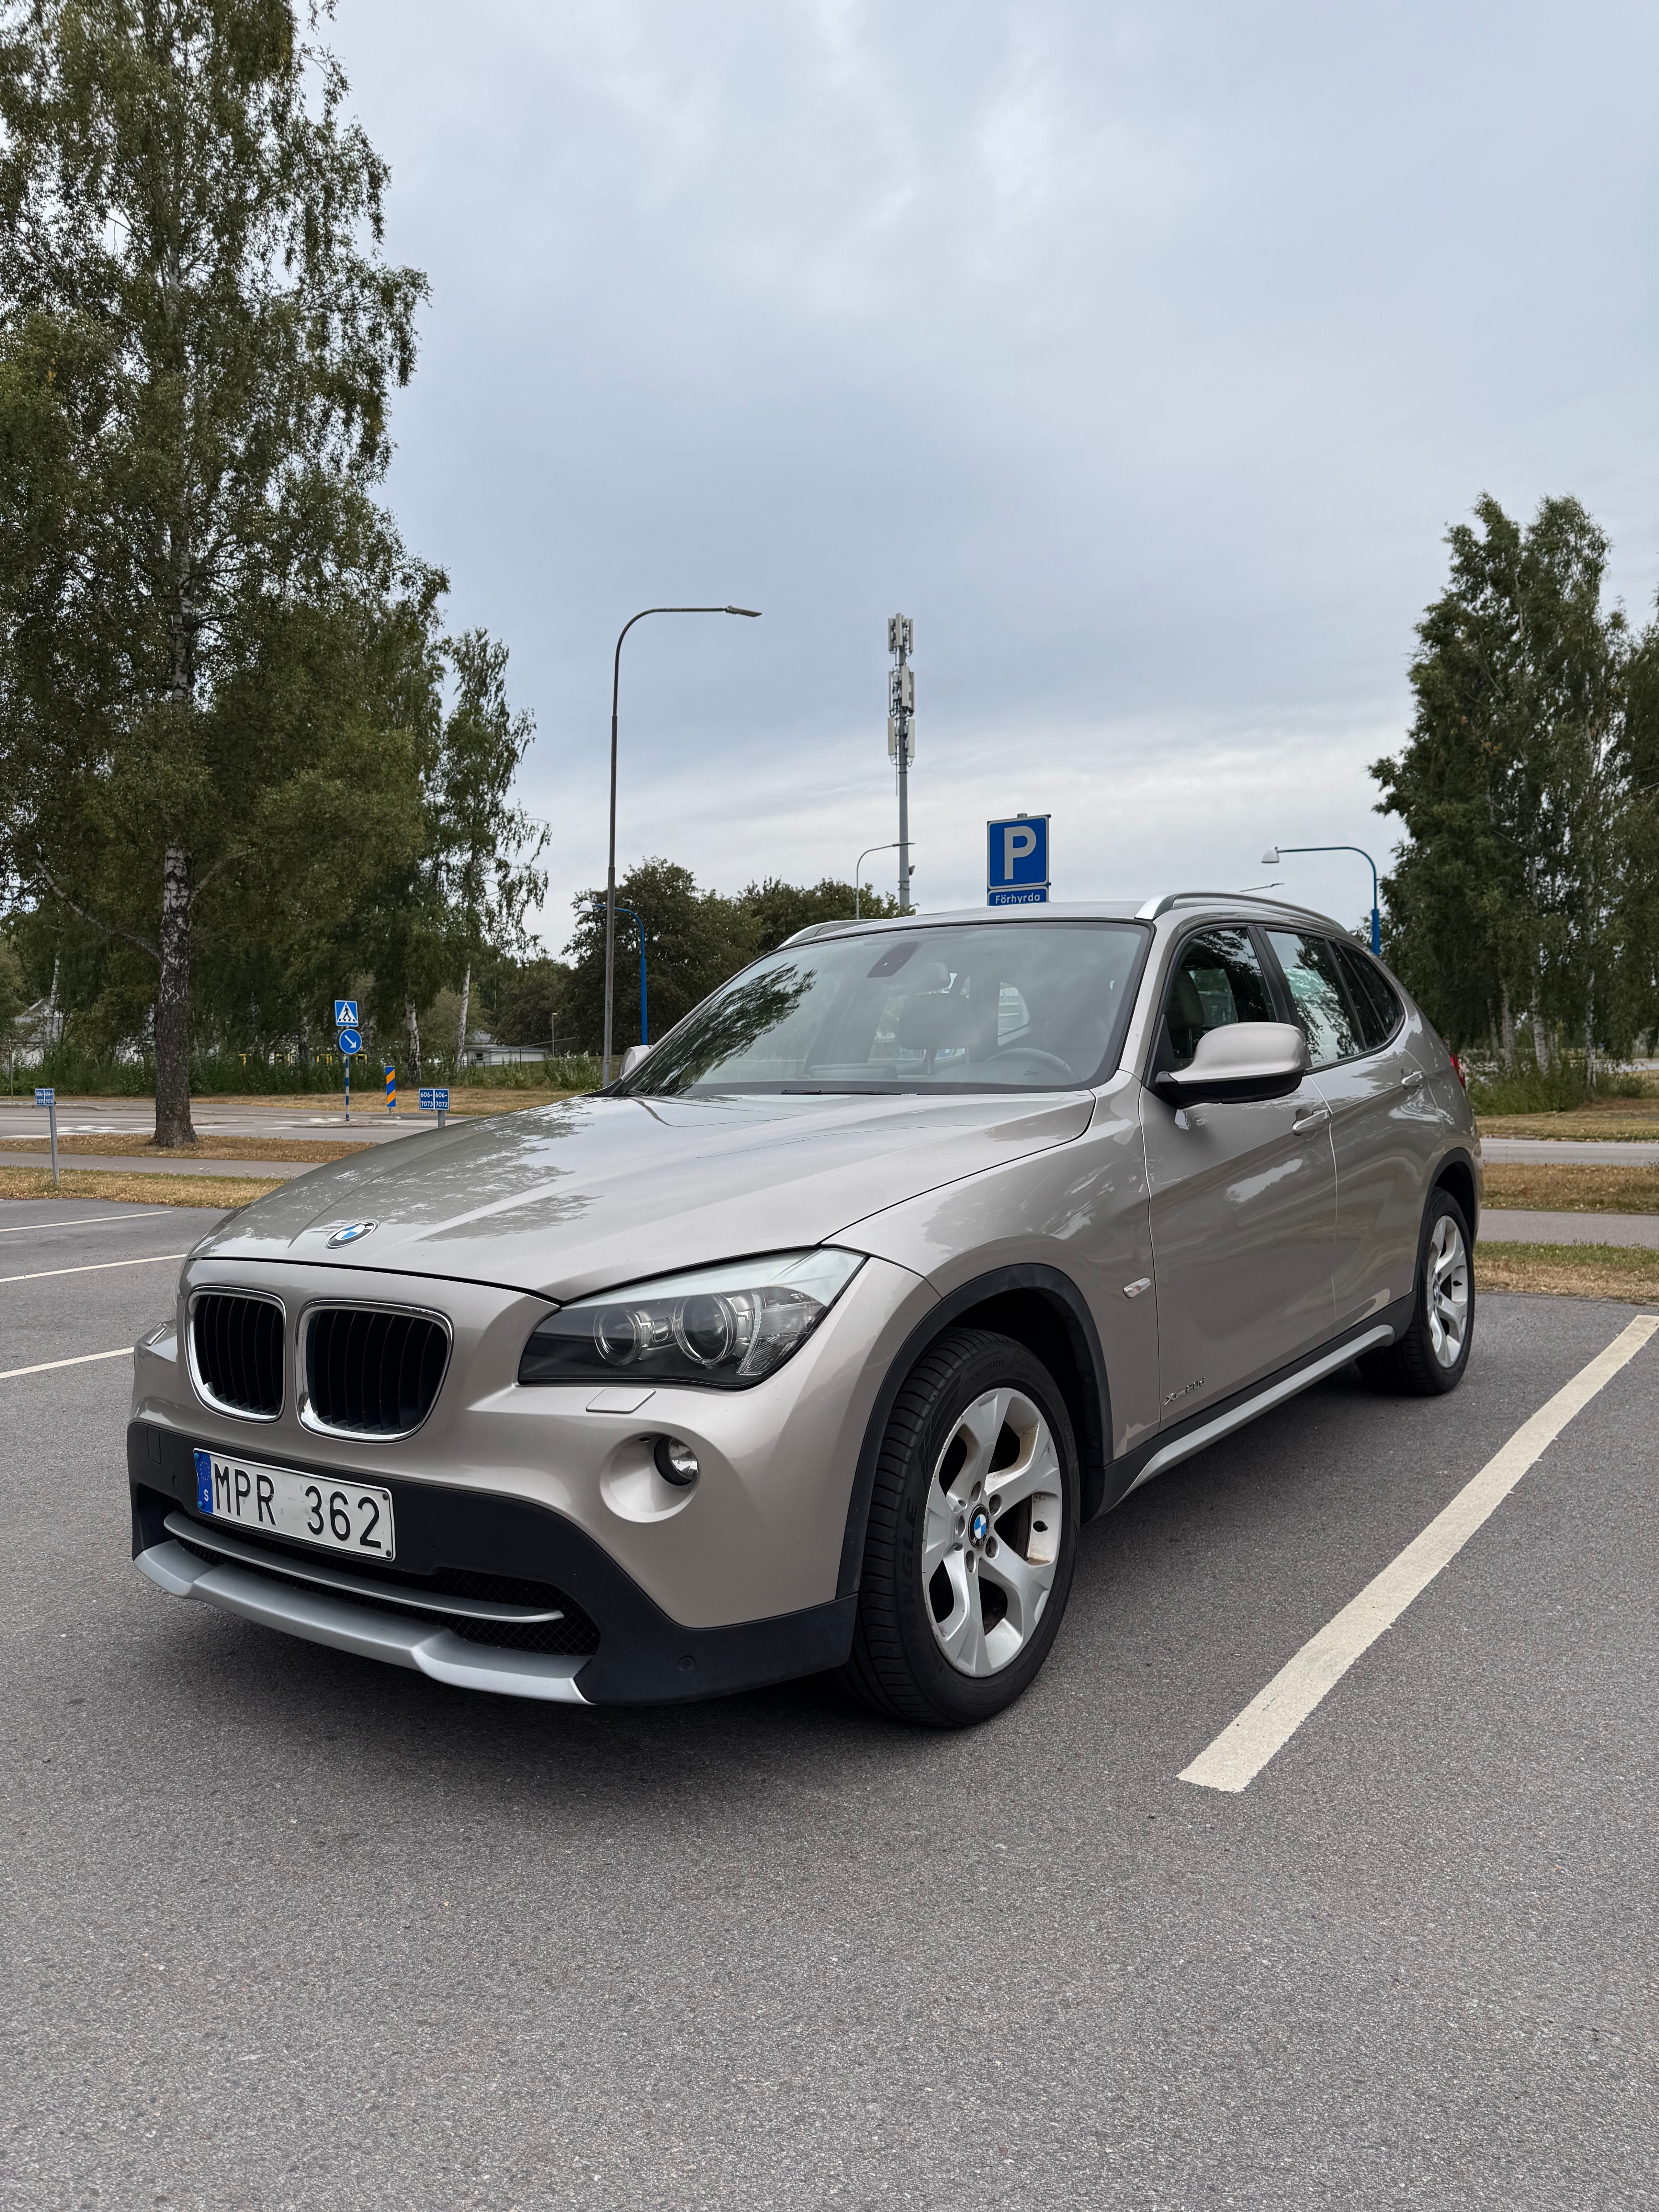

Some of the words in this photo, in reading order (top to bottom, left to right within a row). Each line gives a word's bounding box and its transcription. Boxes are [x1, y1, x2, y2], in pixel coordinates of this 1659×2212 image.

[1004, 825, 1037, 880] P
[995, 893, 1040, 904] Förhyrda
[972, 1359, 1005, 1382] OUTSIDE
[204, 1489, 209, 1502] S
[214, 1462, 276, 1525] MPR
[305, 1485, 381, 1549] 362
